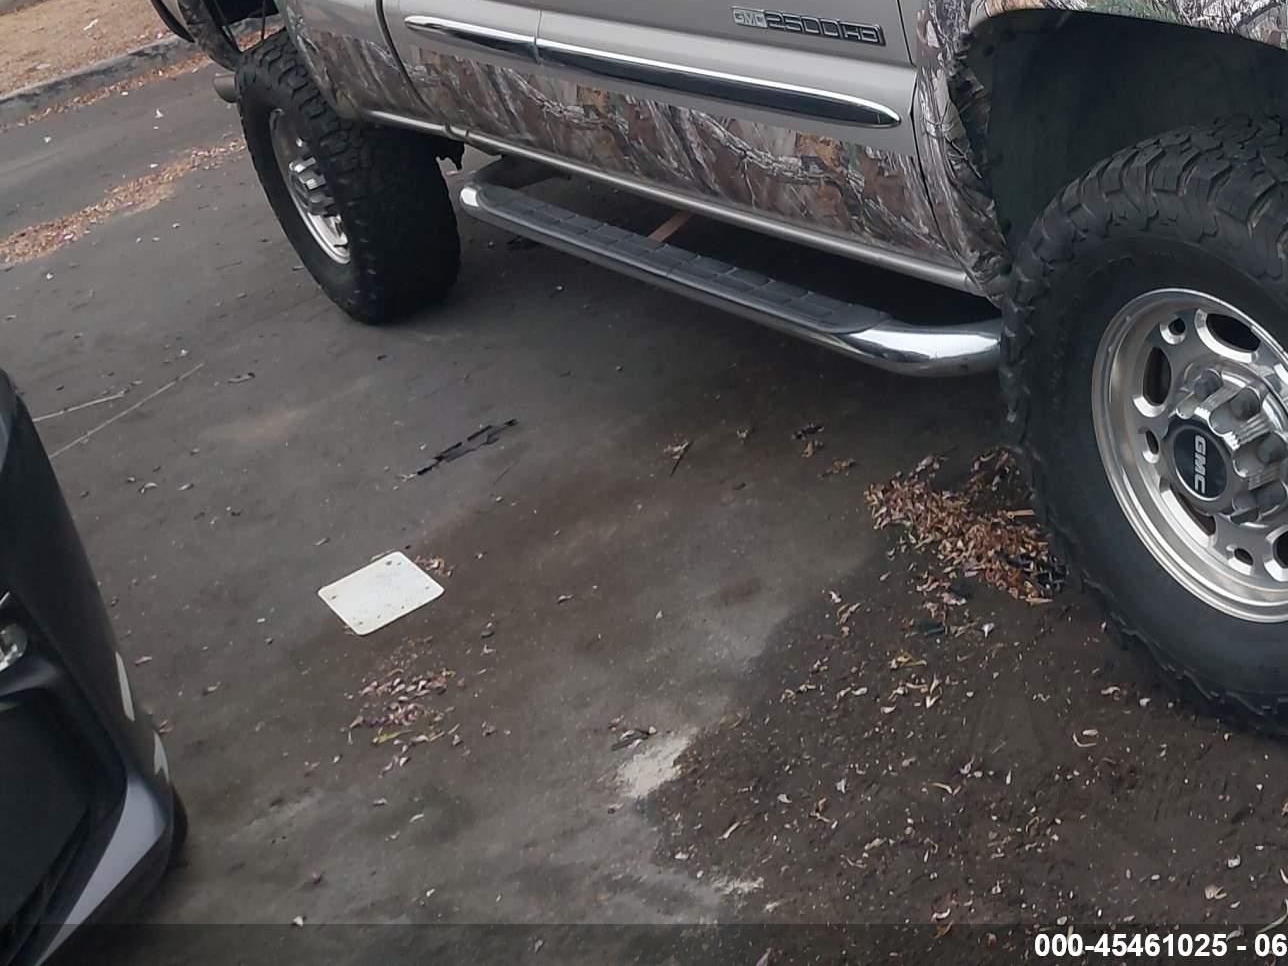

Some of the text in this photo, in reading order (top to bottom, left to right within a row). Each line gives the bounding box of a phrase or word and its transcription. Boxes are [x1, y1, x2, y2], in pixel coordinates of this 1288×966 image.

[733, 8, 883, 44] GMC 2500HD
[1194, 435, 1207, 494] GMC
